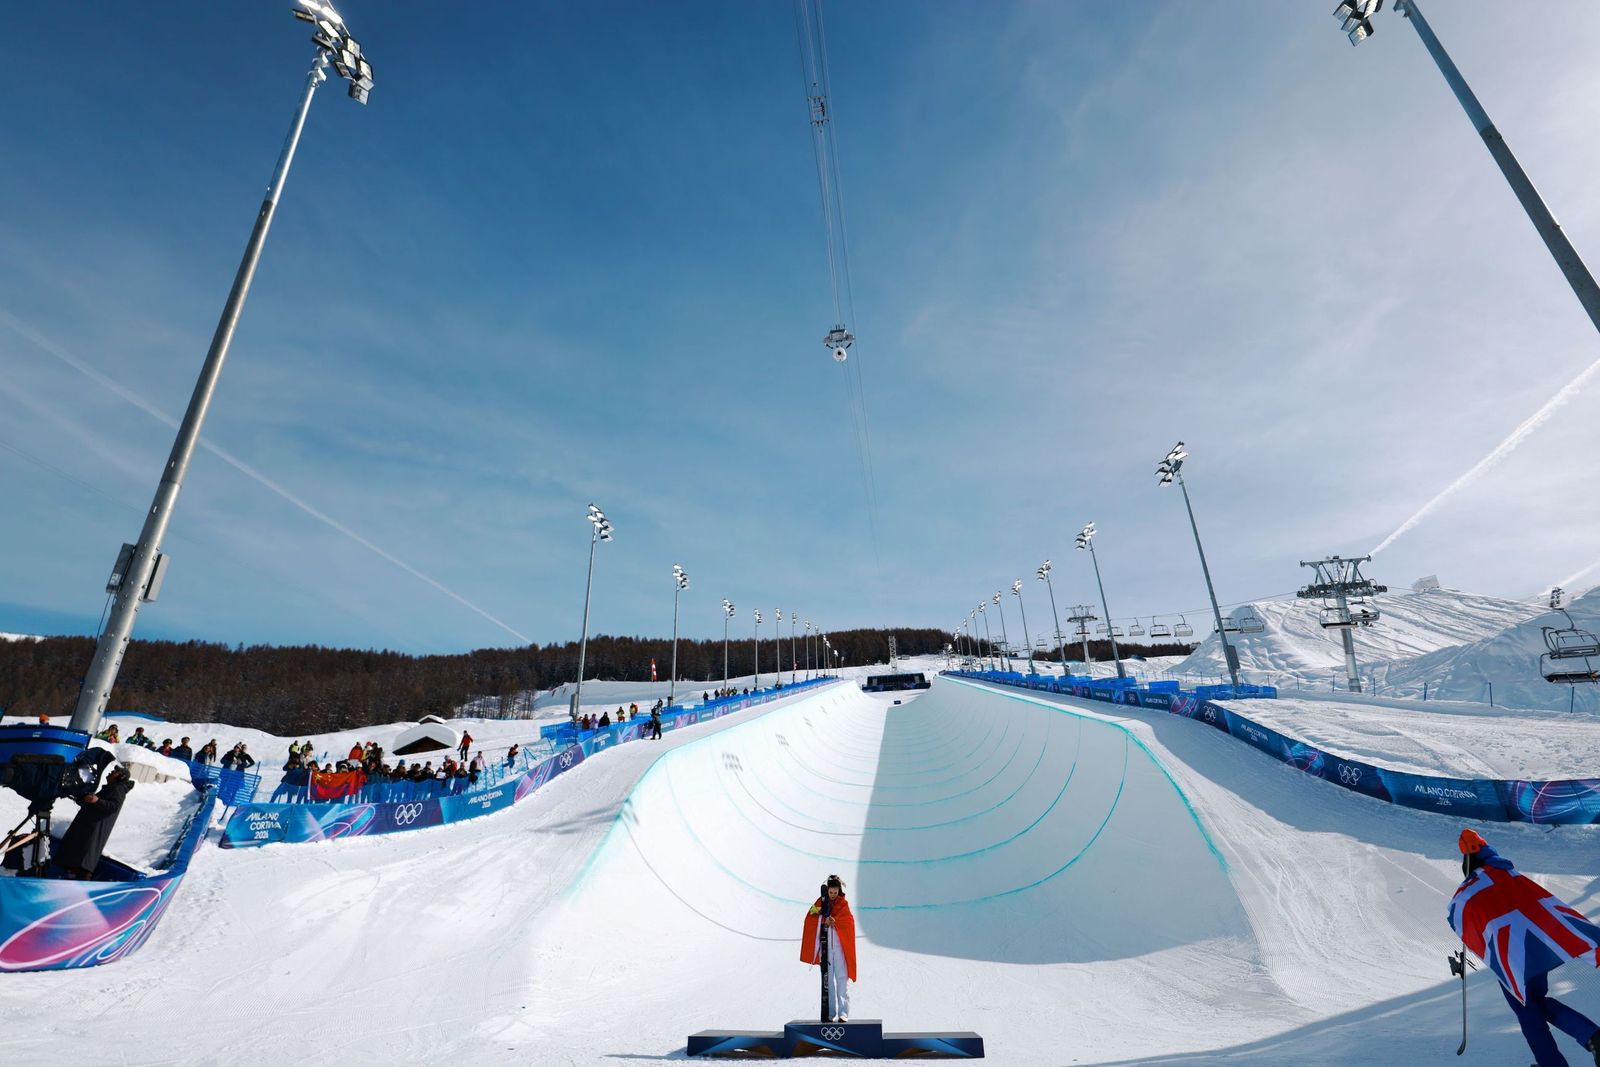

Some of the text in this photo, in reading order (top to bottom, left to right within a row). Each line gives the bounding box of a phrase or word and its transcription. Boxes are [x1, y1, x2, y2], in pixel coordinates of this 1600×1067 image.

[1415, 785, 1444, 797] MILANO
[468, 793, 488, 804] MILANO
[245, 812, 280, 822] MILANO
[250, 821, 282, 831] CORTINA
